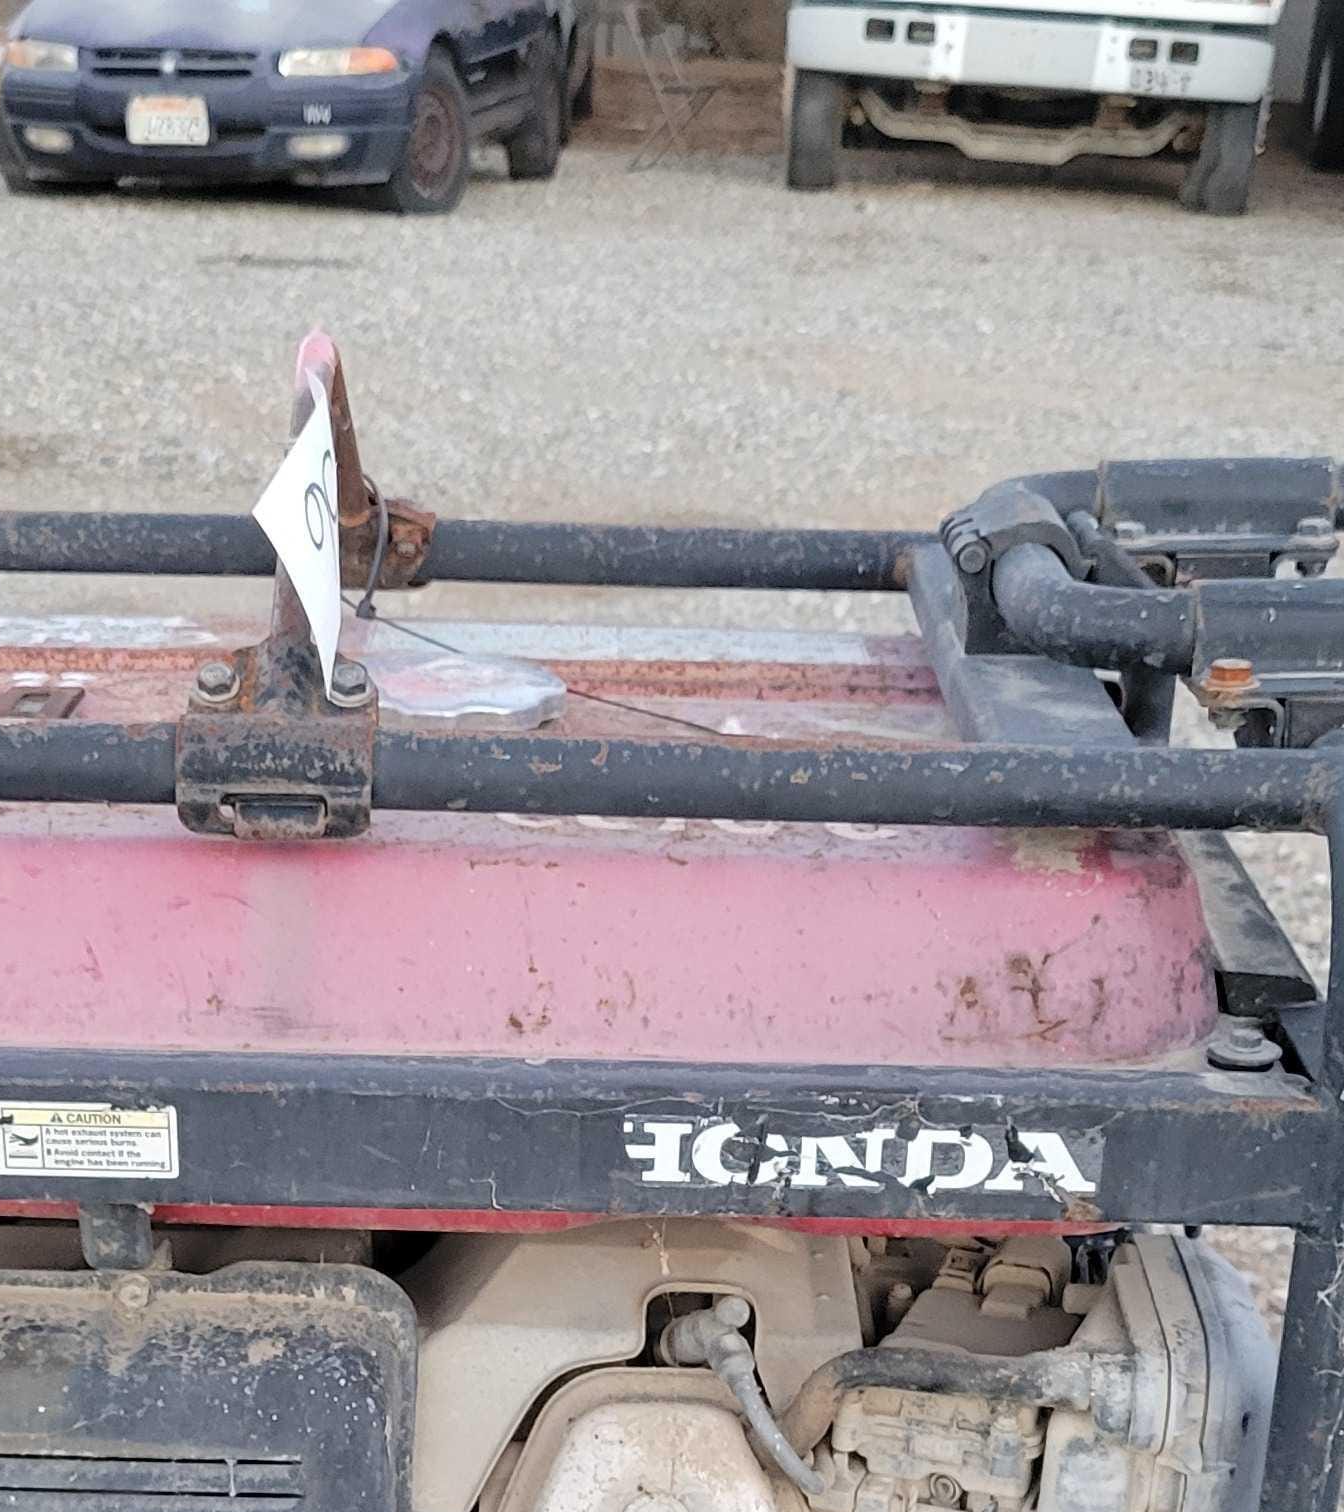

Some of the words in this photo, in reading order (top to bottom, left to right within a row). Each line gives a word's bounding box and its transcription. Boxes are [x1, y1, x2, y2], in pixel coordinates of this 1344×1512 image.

[66, 1113, 122, 1125] CAUTION
[54, 1128, 69, 1137] hot
[71, 1128, 107, 1138] exhaust
[109, 1130, 142, 1140] system
[144, 1131, 162, 1139] can
[75, 1138, 108, 1146] serious
[54, 1149, 79, 1157] Avoid
[81, 1149, 116, 1158] contact
[127, 1150, 142, 1159] the
[54, 1158, 85, 1168] engine
[86, 1158, 104, 1167] has
[106, 1160, 129, 1168] been
[131, 1160, 166, 1170] running
